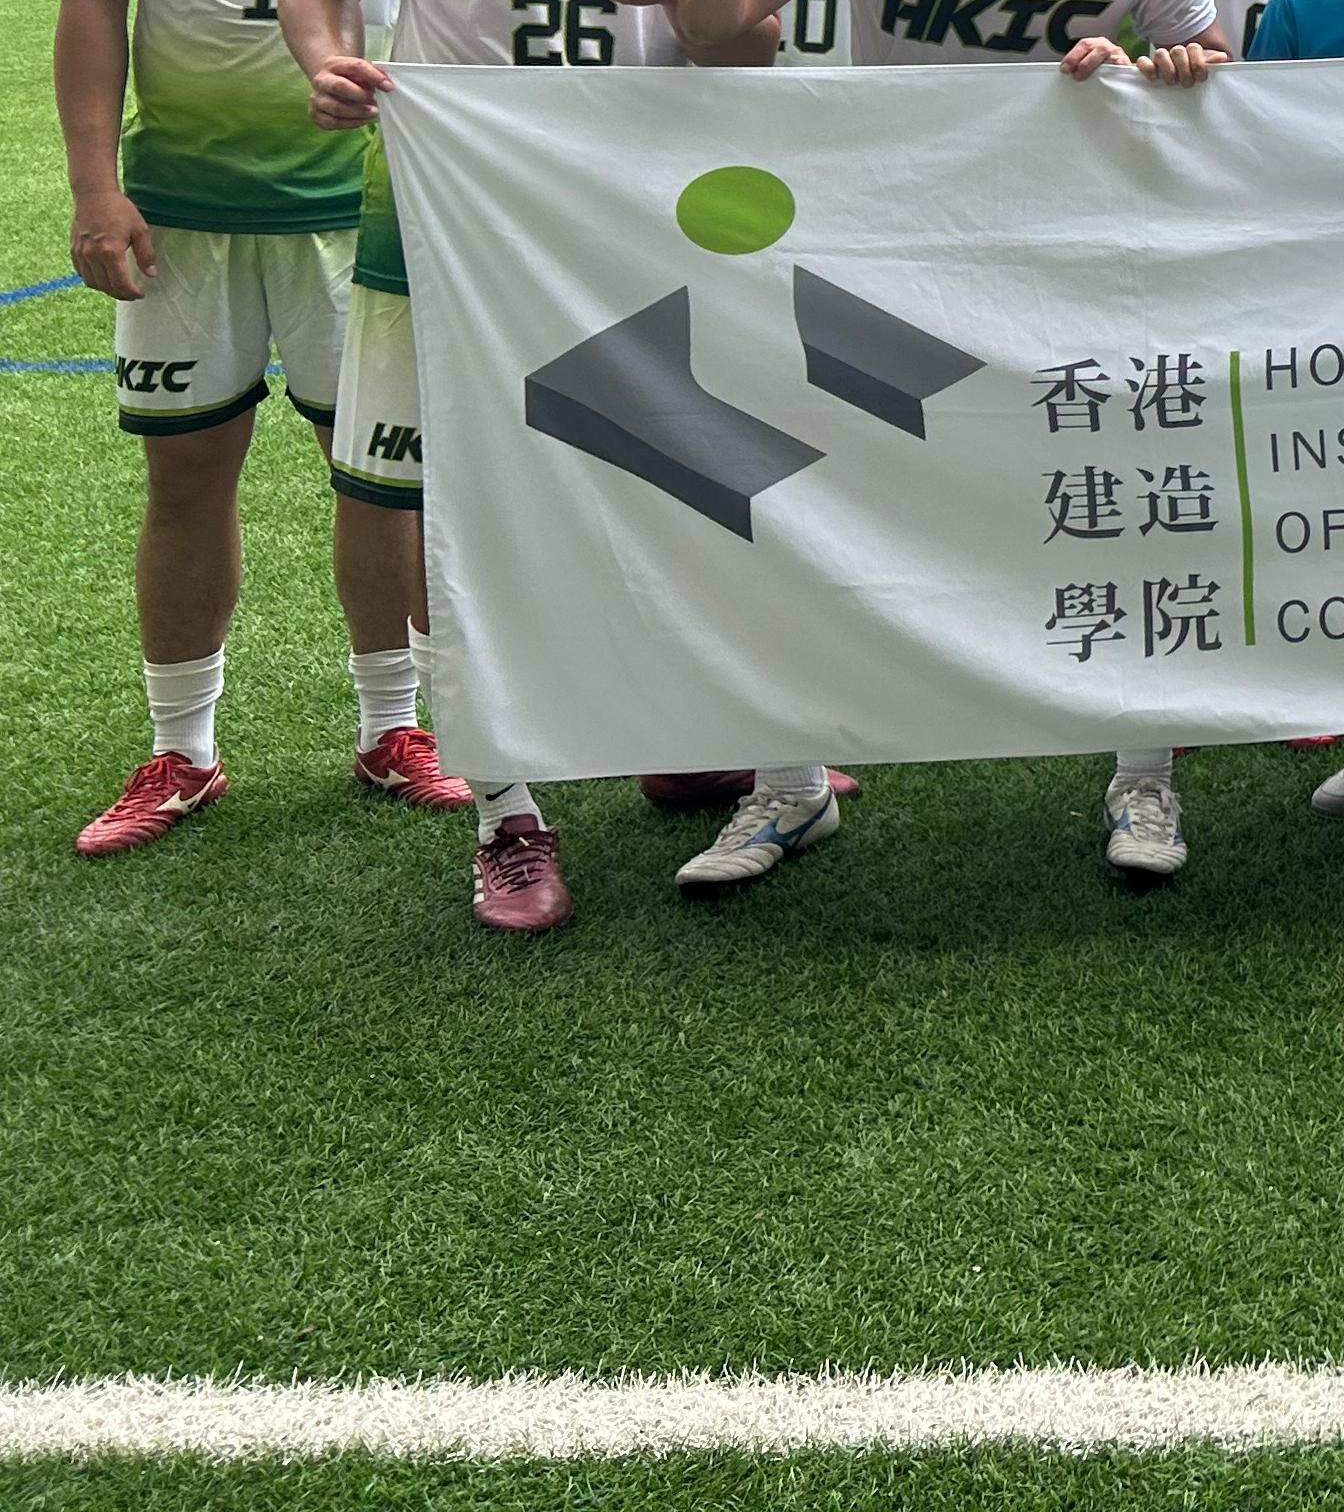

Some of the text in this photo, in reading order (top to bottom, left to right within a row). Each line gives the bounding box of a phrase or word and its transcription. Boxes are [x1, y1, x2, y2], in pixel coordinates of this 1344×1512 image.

[1030, 353, 1208, 436] 香港
[367, 421, 423, 465] HK
[1041, 463, 1220, 546] 建造
[1044, 572, 1223, 664] 學院
